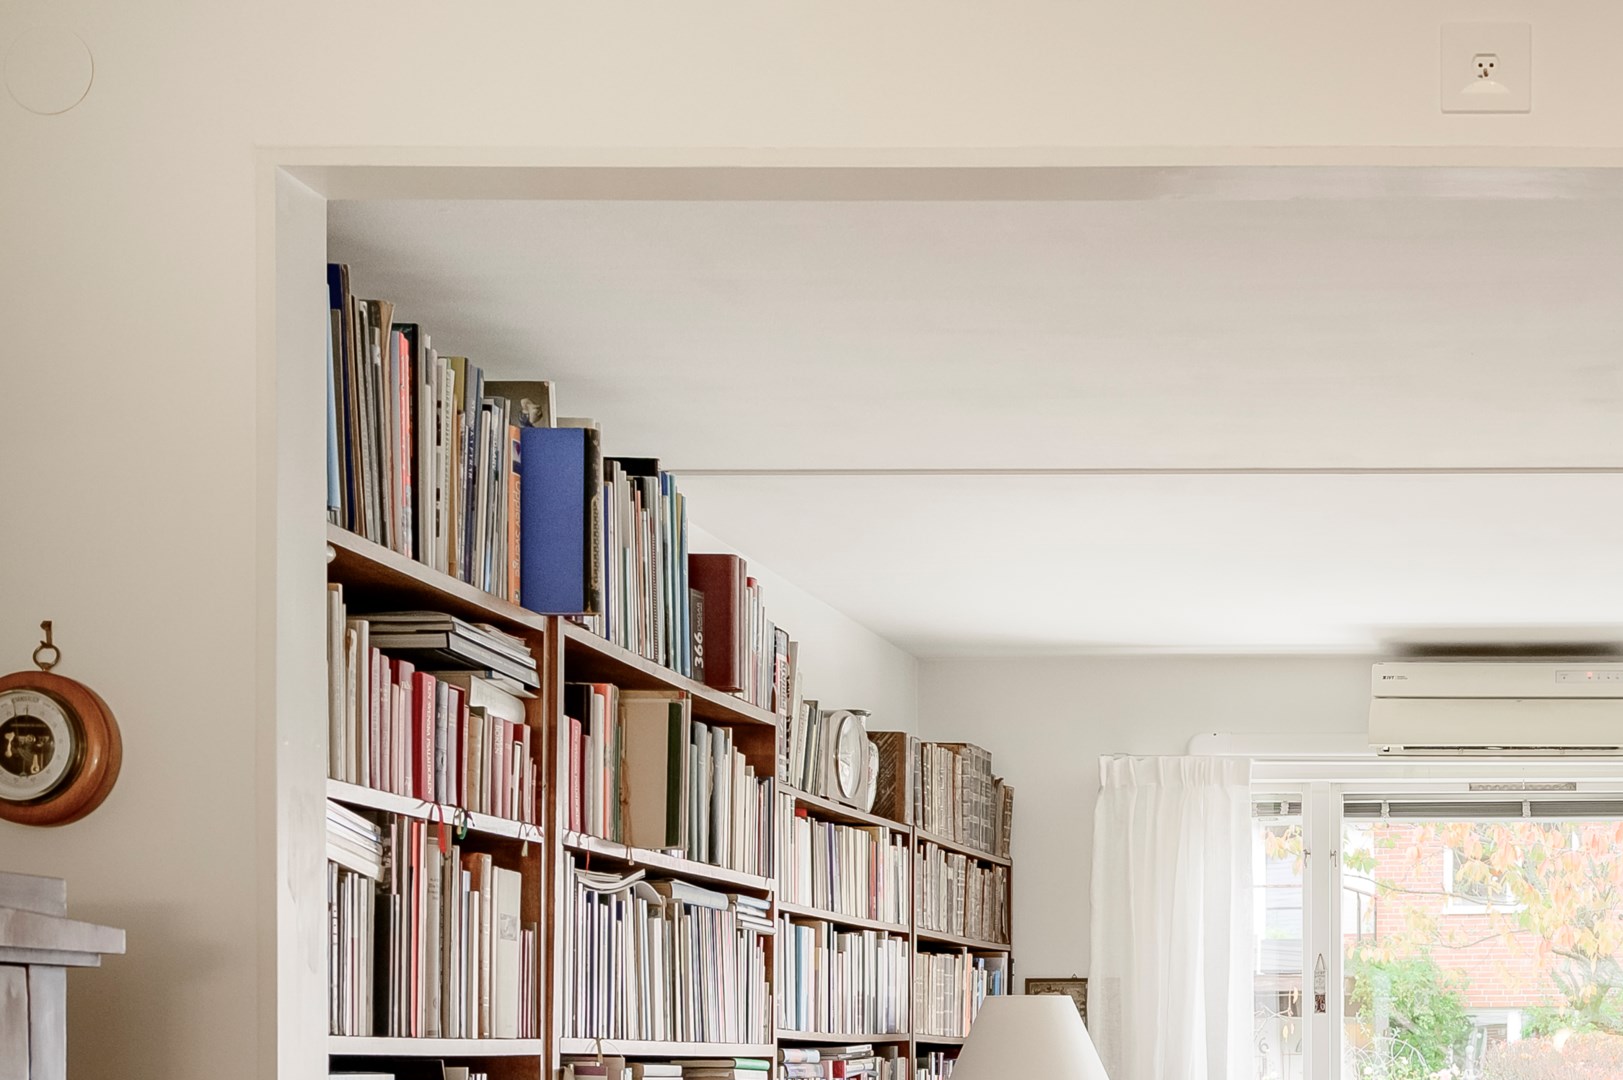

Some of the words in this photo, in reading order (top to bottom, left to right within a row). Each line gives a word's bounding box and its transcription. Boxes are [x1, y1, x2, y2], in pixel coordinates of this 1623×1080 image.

[512, 480, 521, 528] Upplev
[512, 530, 521, 577] Sverige
[693, 631, 704, 669] 366
